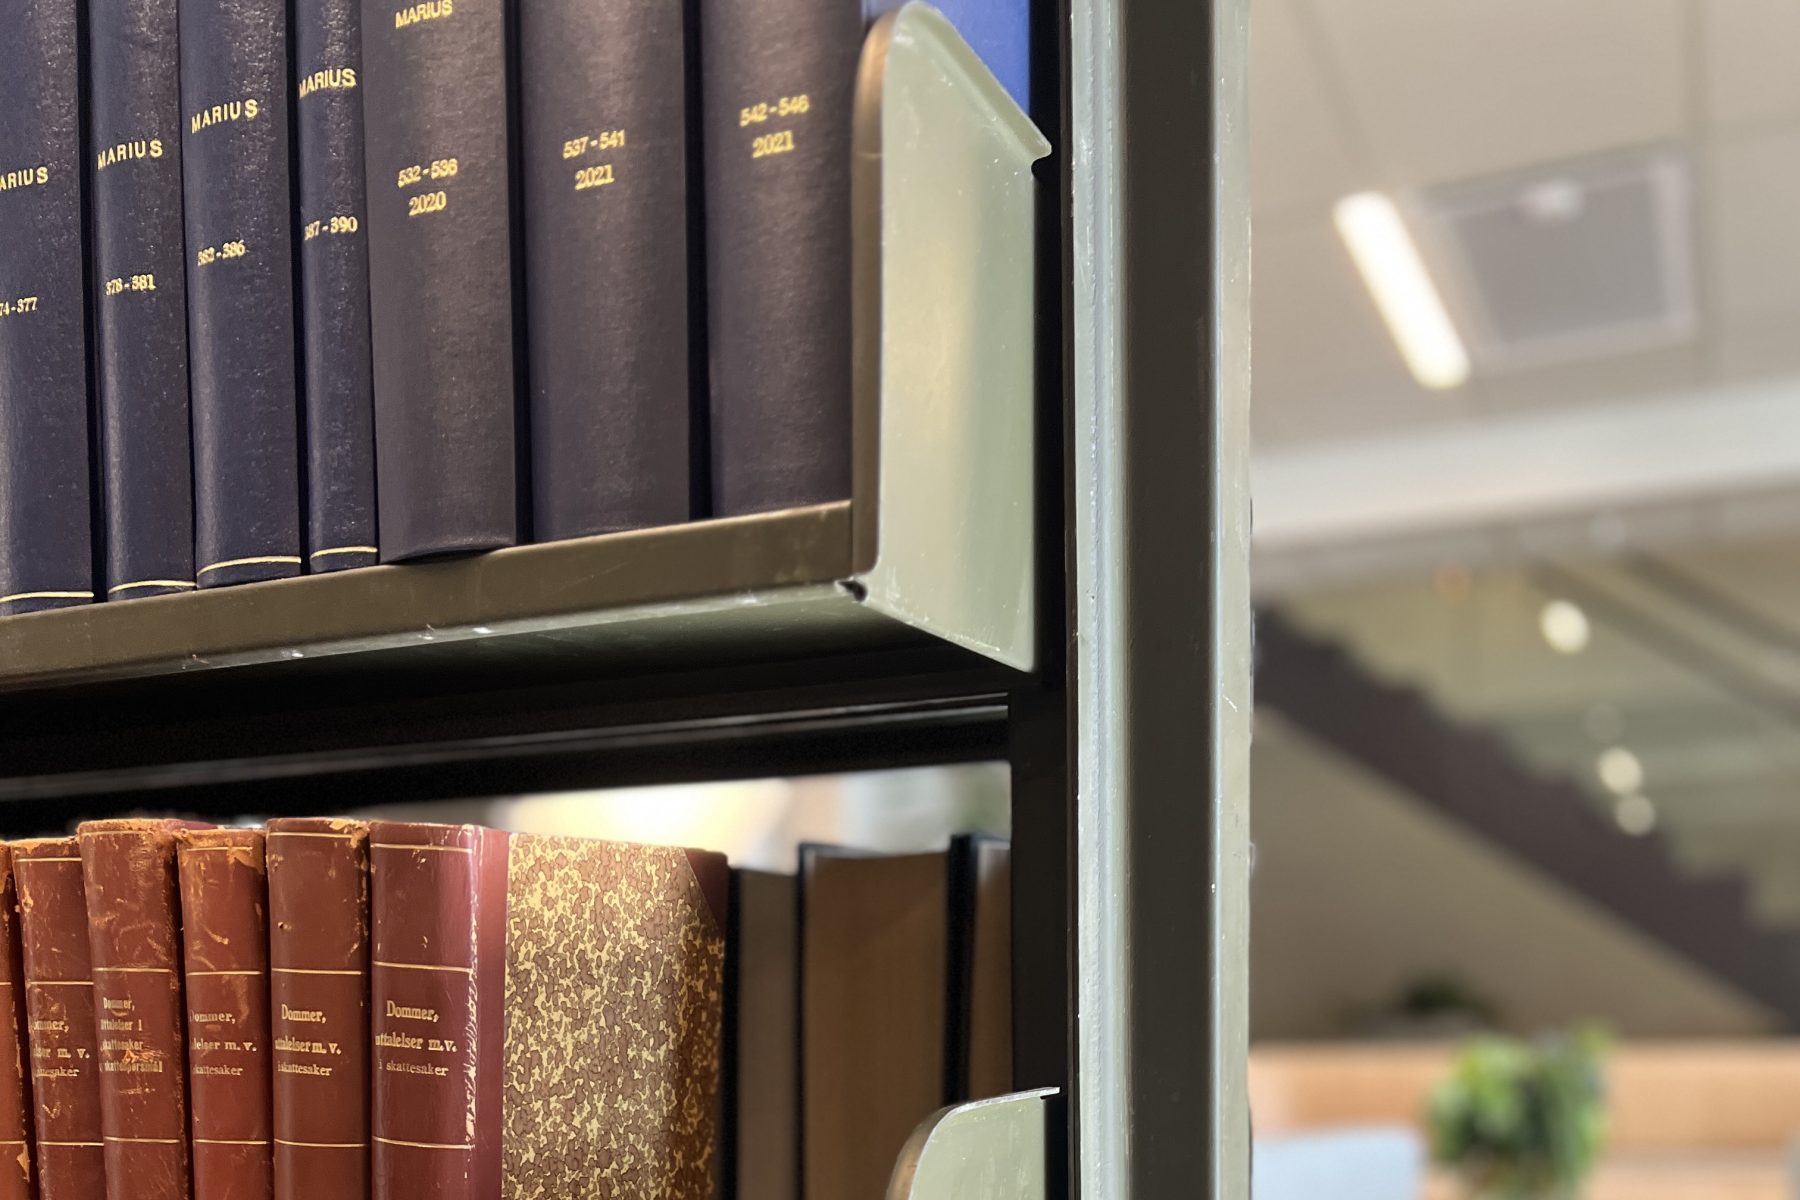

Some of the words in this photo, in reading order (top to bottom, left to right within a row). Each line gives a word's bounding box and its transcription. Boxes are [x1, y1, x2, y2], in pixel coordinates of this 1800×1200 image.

[395, 0, 453, 29] MARIUS
[300, 68, 357, 98] MARIUS
[191, 98, 258, 134] MARIUS
[97, 139, 163, 170] MARIUS
[563, 129, 626, 159] 537-541
[752, 130, 795, 158] 2021
[0, 166, 49, 191] ARIUS
[575, 164, 615, 190] 2021
[408, 191, 446, 216] 2020
[281, 1003, 327, 1024] Dommer,
[386, 1000, 439, 1023] Dommer,
[375, 1032, 424, 1050] uttalelser
[386, 1060, 449, 1077] skattesaker
